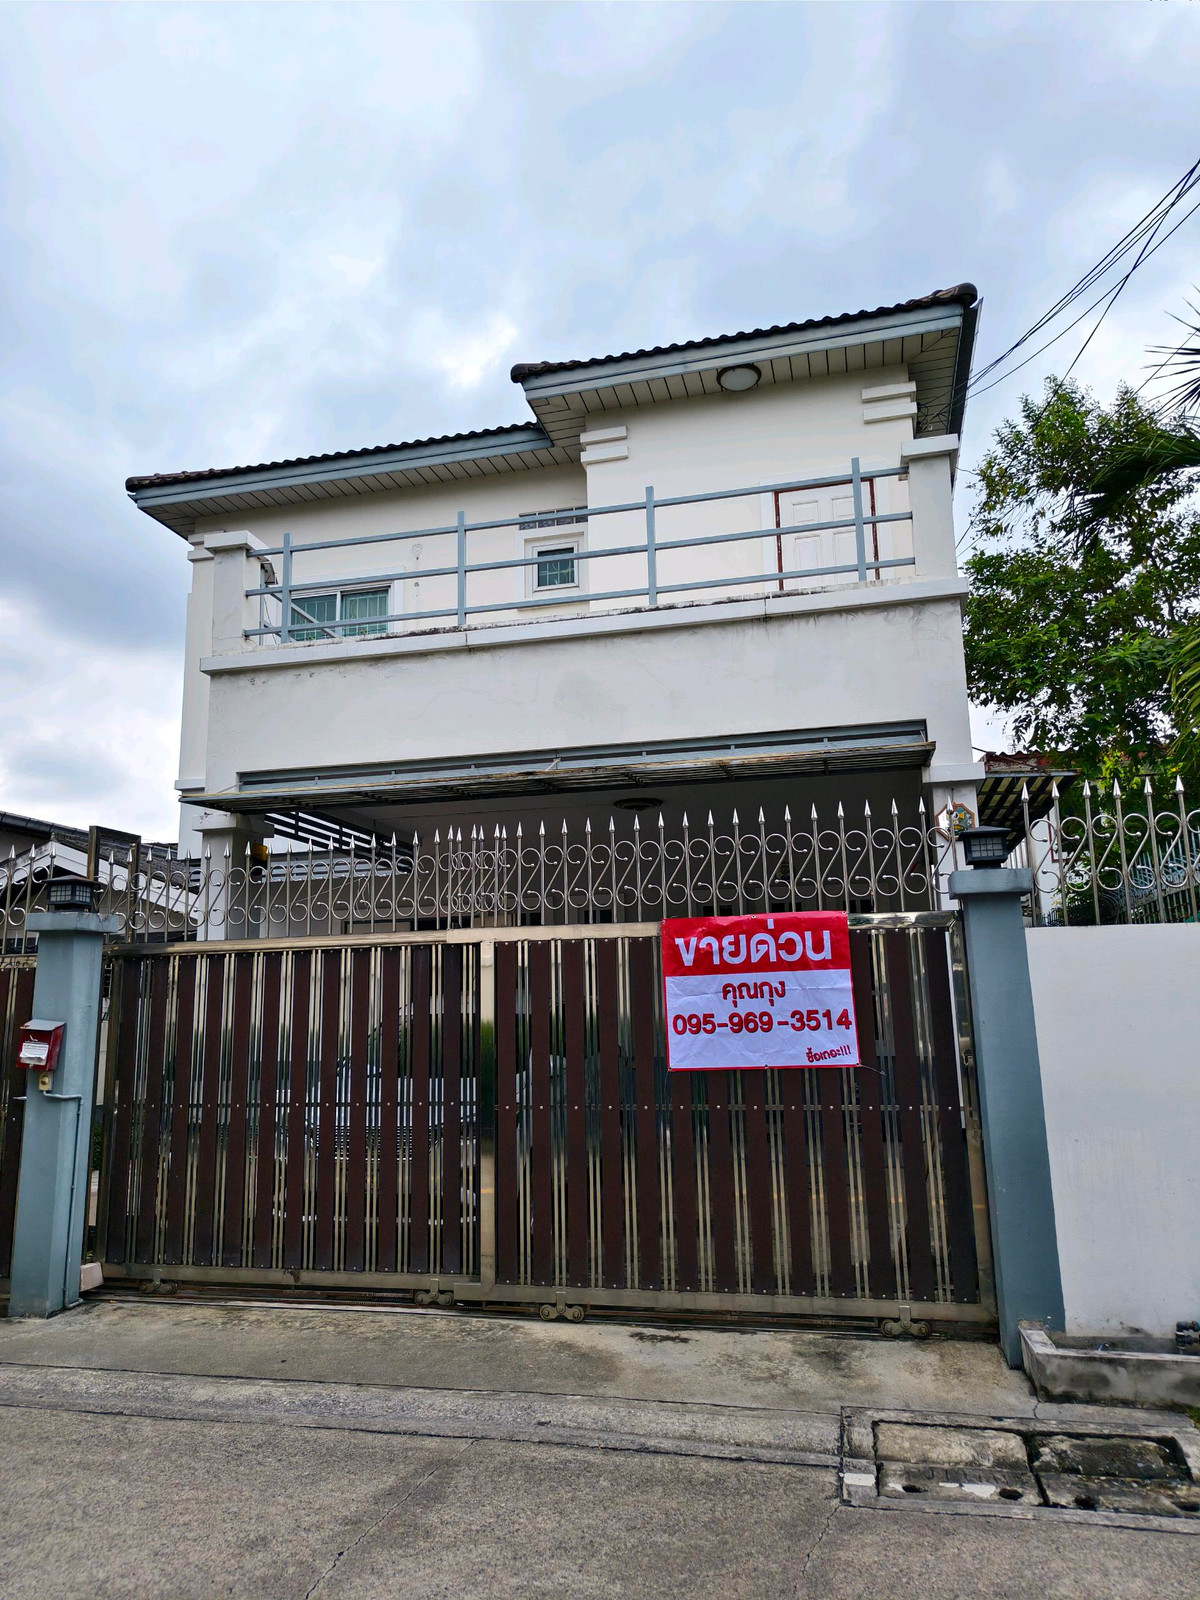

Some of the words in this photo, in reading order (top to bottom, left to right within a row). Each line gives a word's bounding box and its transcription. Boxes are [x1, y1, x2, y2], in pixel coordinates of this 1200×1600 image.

[675, 918, 832, 966] ขายด่วน
[722, 981, 786, 1008] คุณกุง
[672, 1008, 852, 1035] 095-969-3514
